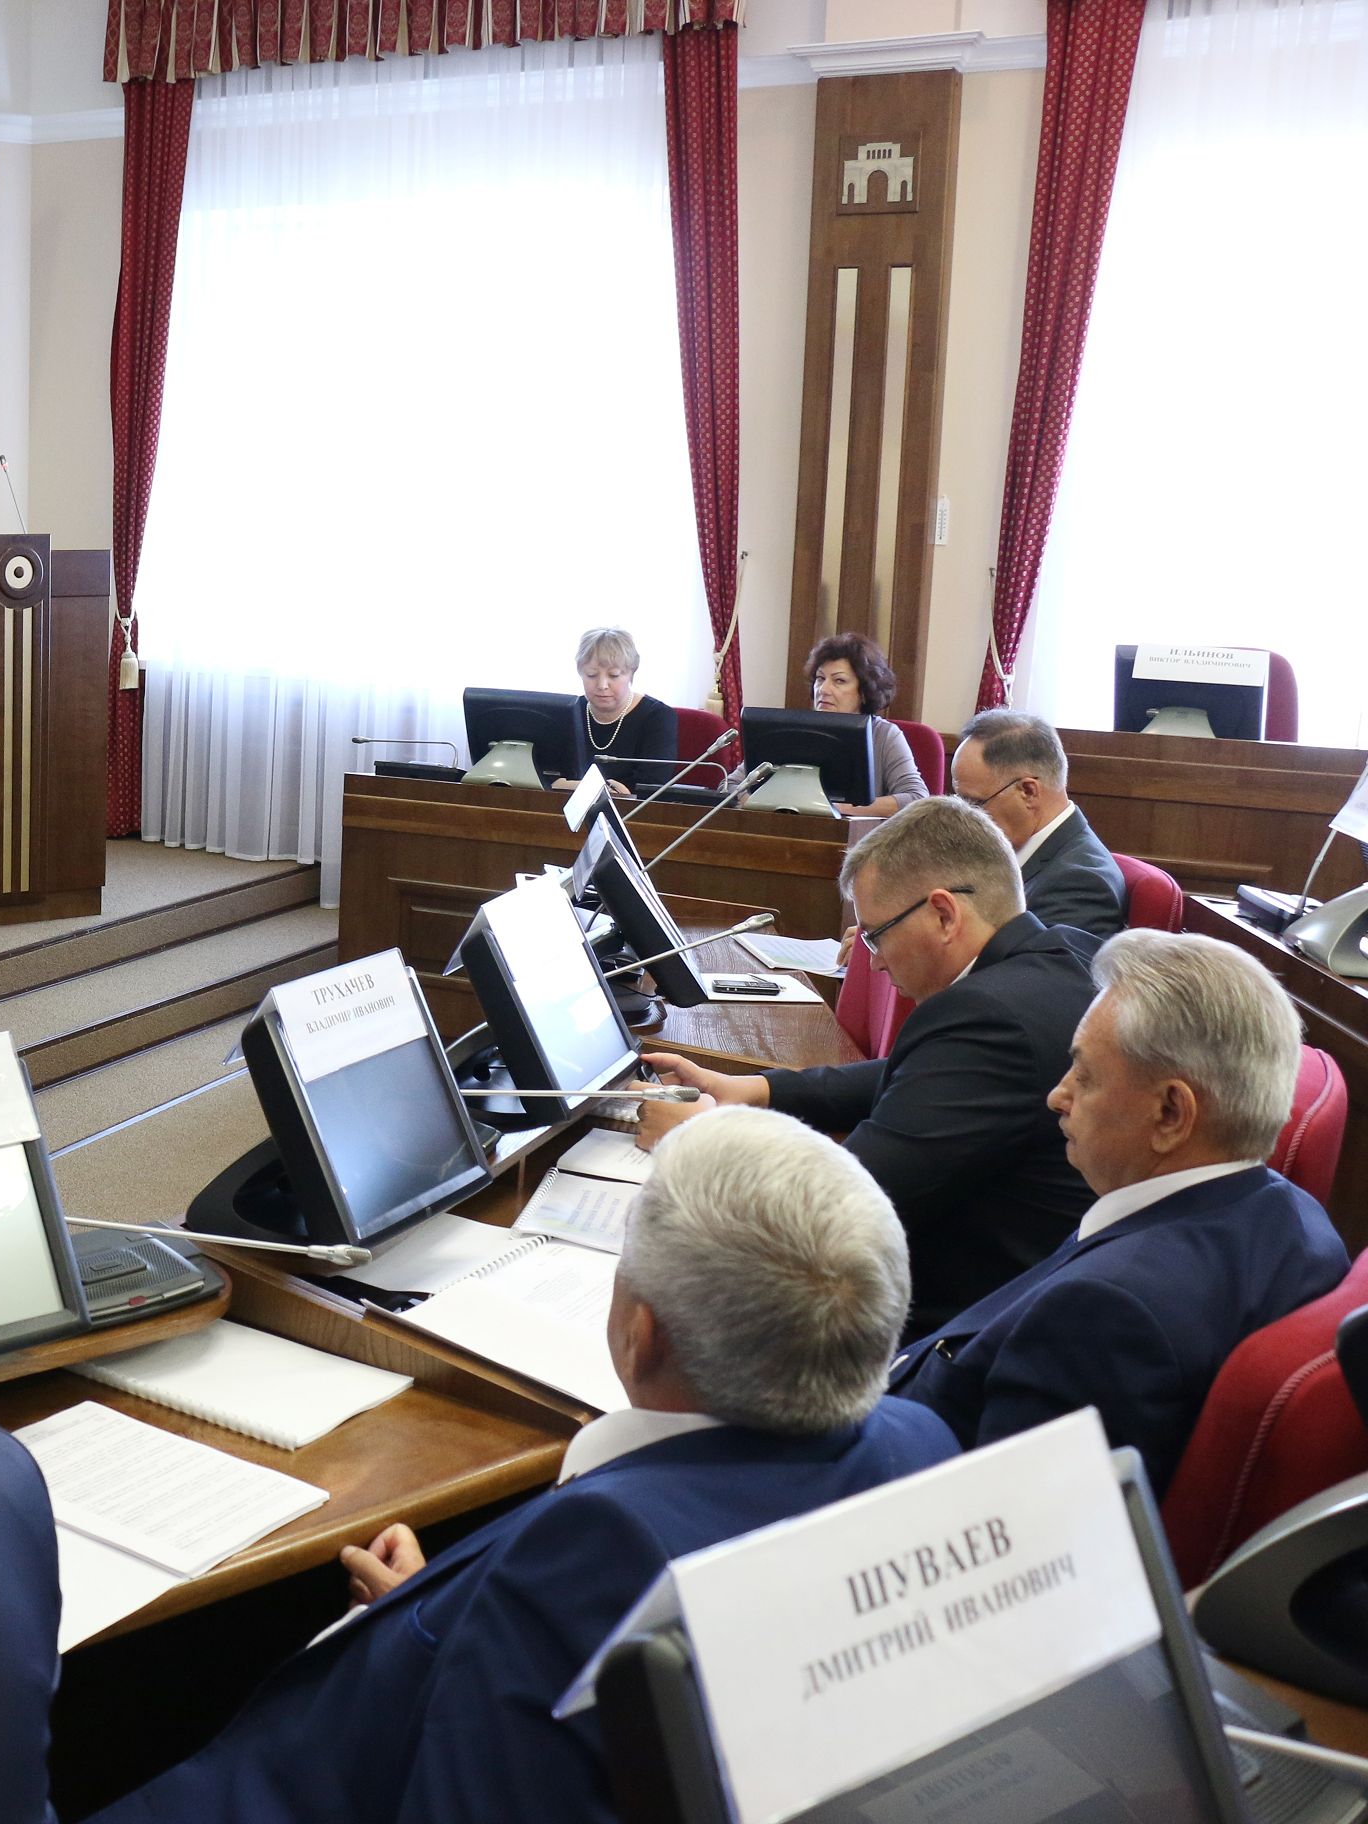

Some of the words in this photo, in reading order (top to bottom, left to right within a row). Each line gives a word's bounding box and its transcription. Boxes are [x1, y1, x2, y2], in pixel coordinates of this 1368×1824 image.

[1149, 656, 1181, 664] ВИКТОР
[1169, 648, 1234, 660] ИЛЬИНОВ
[311, 973, 375, 1006] ТРУХАЧЕВ
[305, 1009, 352, 1034] ВЛАДИМИР
[353, 995, 396, 1019] ИВАНОВИЧ
[846, 1516, 1012, 1617] ШУВАЕВ
[802, 1608, 936, 1701] ДМИТРИЙ
[943, 1552, 1077, 1634] ИВАНОВИЧ
